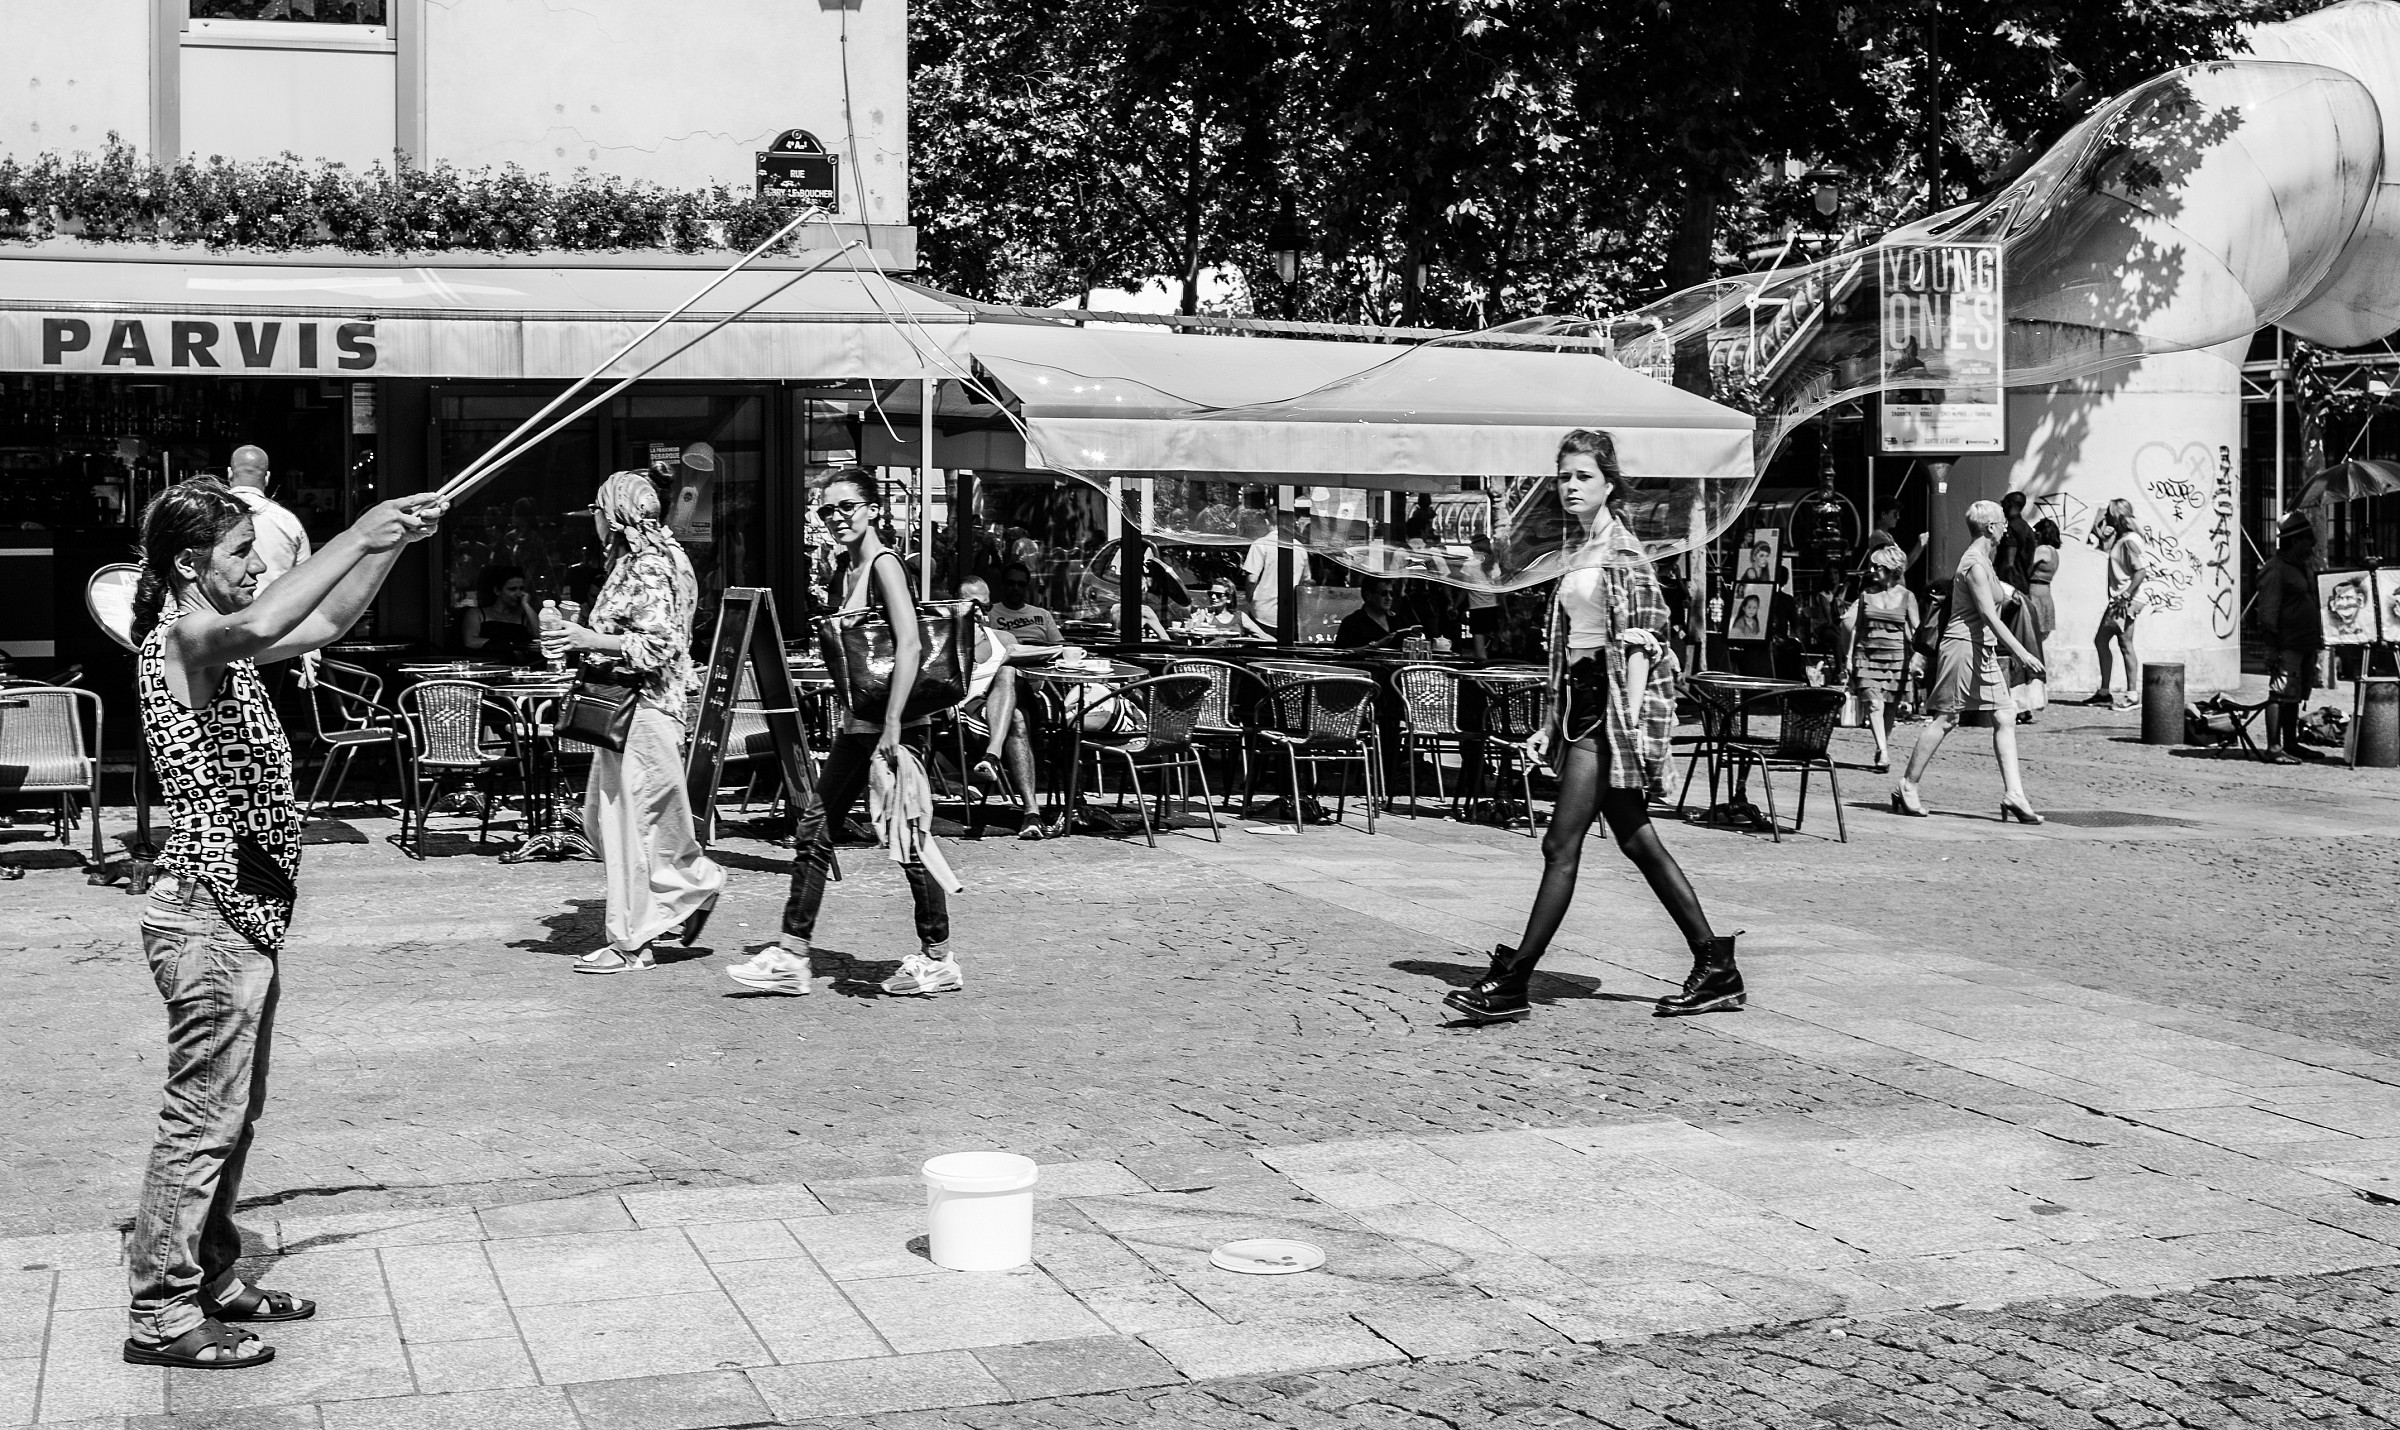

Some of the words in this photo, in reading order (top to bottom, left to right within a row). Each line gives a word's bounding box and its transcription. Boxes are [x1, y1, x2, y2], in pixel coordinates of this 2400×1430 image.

[790, 170, 805, 178] RUE
[800, 189, 833, 198] BOUCHER
[1887, 247, 1994, 293] YOUNG
[42, 318, 377, 370] PARVIS
[1888, 293, 1994, 350] ONES
